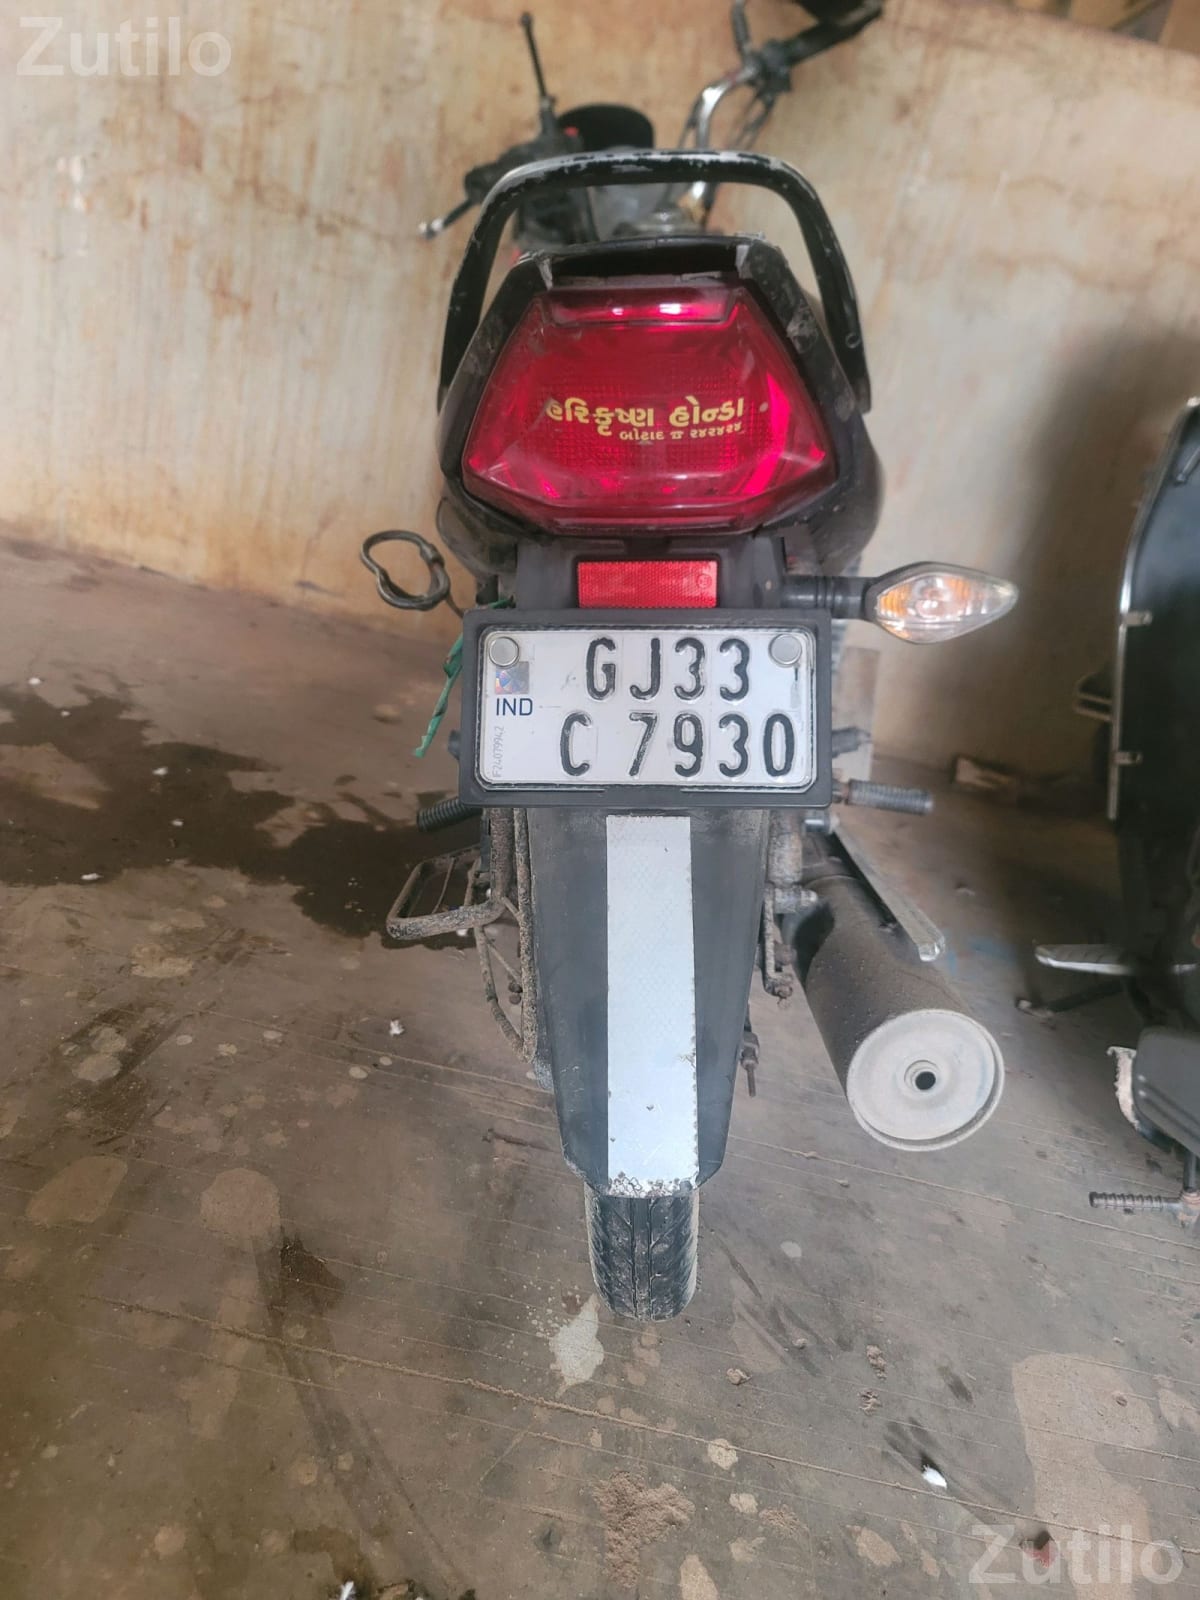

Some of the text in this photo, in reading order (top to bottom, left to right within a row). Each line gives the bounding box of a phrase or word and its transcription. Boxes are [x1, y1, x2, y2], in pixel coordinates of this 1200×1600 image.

[546, 395, 744, 436] હરિકૃષ્ણ હોન્ડા
[586, 637, 750, 701] GJ33
[496, 697, 533, 716] IND
